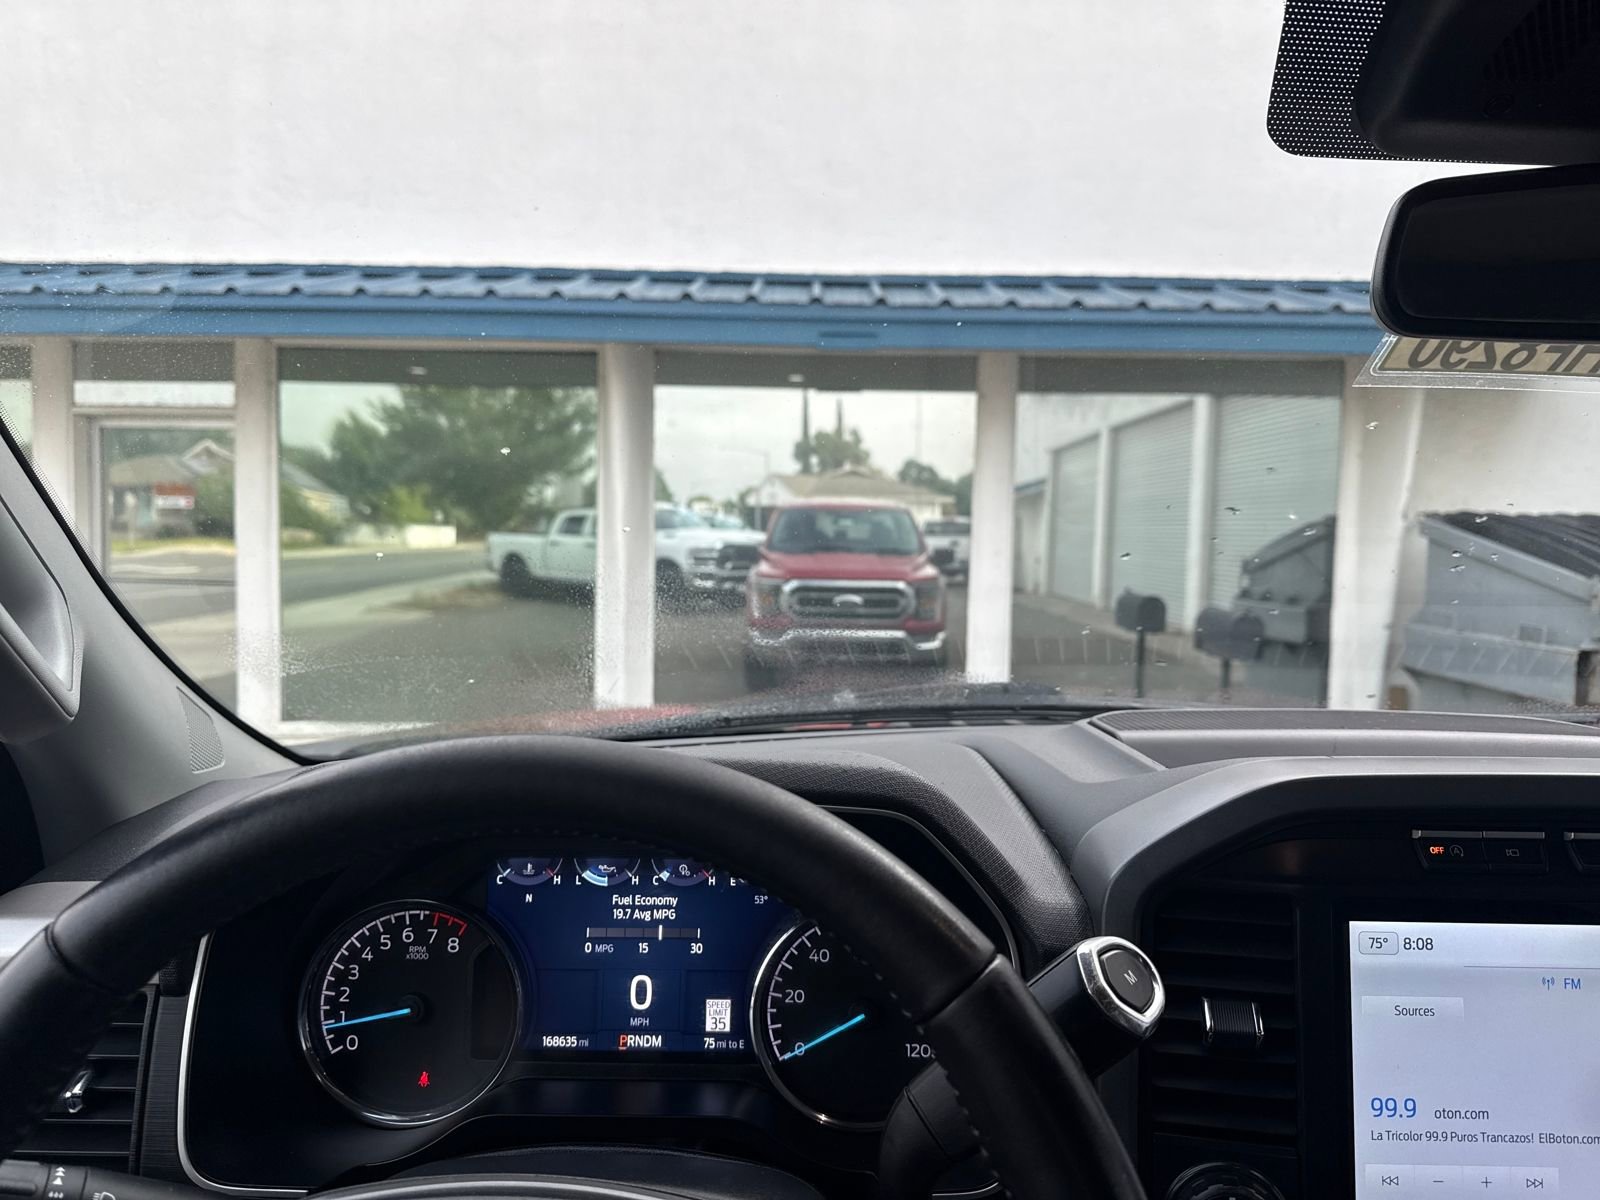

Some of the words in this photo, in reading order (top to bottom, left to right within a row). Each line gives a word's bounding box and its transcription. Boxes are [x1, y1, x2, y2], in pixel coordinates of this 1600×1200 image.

[1429, 846, 1445, 855] OFF
[496, 874, 504, 886] C
[552, 874, 562, 886] H
[575, 874, 582, 886] L
[631, 874, 640, 886] H
[652, 874, 660, 887] C
[707, 875, 717, 887] H
[525, 893, 533, 903] N
[612, 894, 633, 906] Fuel
[634, 894, 679, 908] Economy
[612, 908, 632, 920] 19.7
[632, 908, 652, 922] Avg
[653, 908, 676, 920] MPG
[379, 934, 392, 950] 5
[402, 927, 414, 943] 6
[427, 928, 438, 944] 7
[447, 937, 460, 953] 8
[584, 941, 592, 954] 0
[594, 943, 614, 953] MPG
[638, 942, 649, 954] 15
[690, 942, 703, 954] 30
[1368, 936, 1389, 950] 75°
[1403, 937, 1434, 951] 8:08
[360, 945, 374, 962] 4
[808, 948, 830, 963] 40
[348, 964, 360, 980] 3
[1123, 969, 1138, 985] M
[1563, 977, 1581, 990] FM
[338, 986, 350, 1002] 2
[630, 974, 653, 1011] 0
[784, 989, 805, 1004] 20
[706, 1000, 731, 1009] SPEED
[1394, 1004, 1436, 1017] Sources
[339, 1010, 348, 1024] 1
[629, 1016, 650, 1027] MPH
[710, 1016, 727, 1031] 35
[346, 1034, 359, 1051] 0
[542, 1035, 578, 1048] 168635
[578, 1037, 589, 1047] mi
[618, 1034, 662, 1050] PRNDM
[703, 1037, 716, 1049] 75
[716, 1039, 727, 1049] mi
[728, 1039, 738, 1049] to
[793, 1042, 806, 1056] 0
[905, 1043, 931, 1058] 120
[1370, 1097, 1417, 1119] 99.9
[1434, 1107, 1490, 1120] oton.com
[1370, 1129, 1384, 1141] La
[1384, 1130, 1424, 1142] Tricolor
[1424, 1130, 1448, 1142] 99.9
[1450, 1131, 1479, 1143] Puros
[1479, 1131, 1534, 1144] Trancazos!
